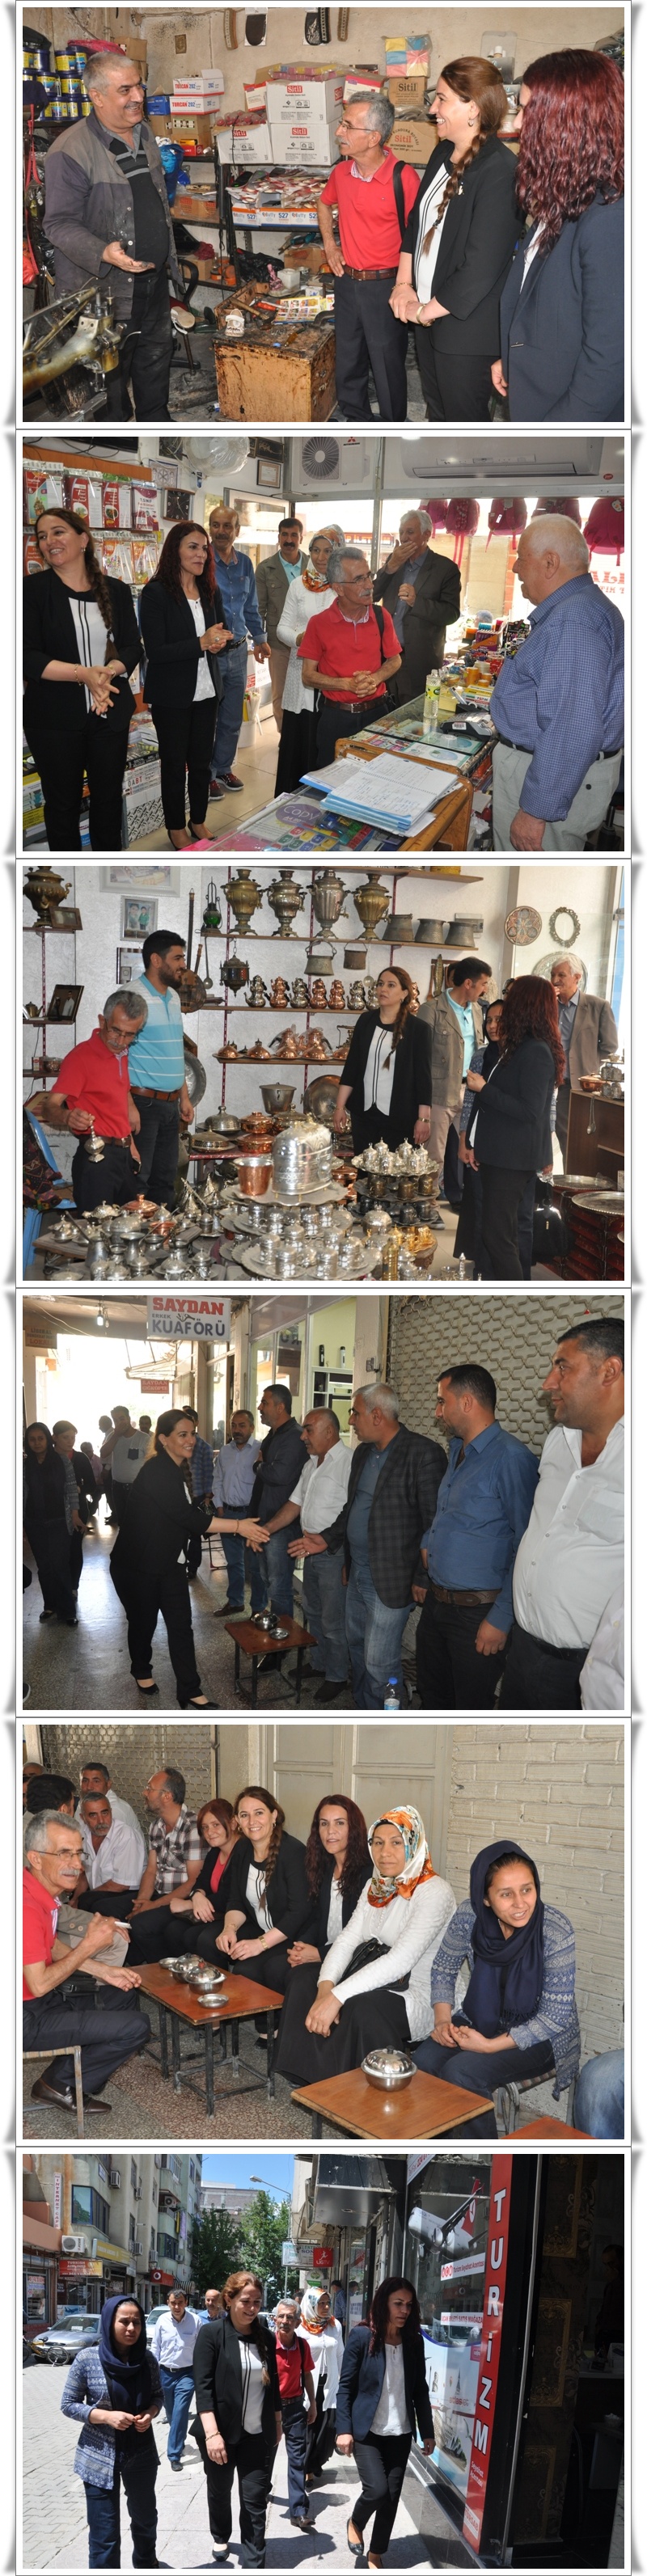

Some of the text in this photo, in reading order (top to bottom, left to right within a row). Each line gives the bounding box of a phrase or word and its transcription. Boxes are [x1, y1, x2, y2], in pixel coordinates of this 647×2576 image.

[398, 82, 417, 91] Sitil
[394, 134, 412, 143] Sitil
[153, 1297, 224, 1315] SAYDAN
[152, 1318, 225, 1337] KUAFÖRÜ
[458, 2316, 467, 2324] SATIŞ
[473, 2187, 507, 2456] TURİZM
